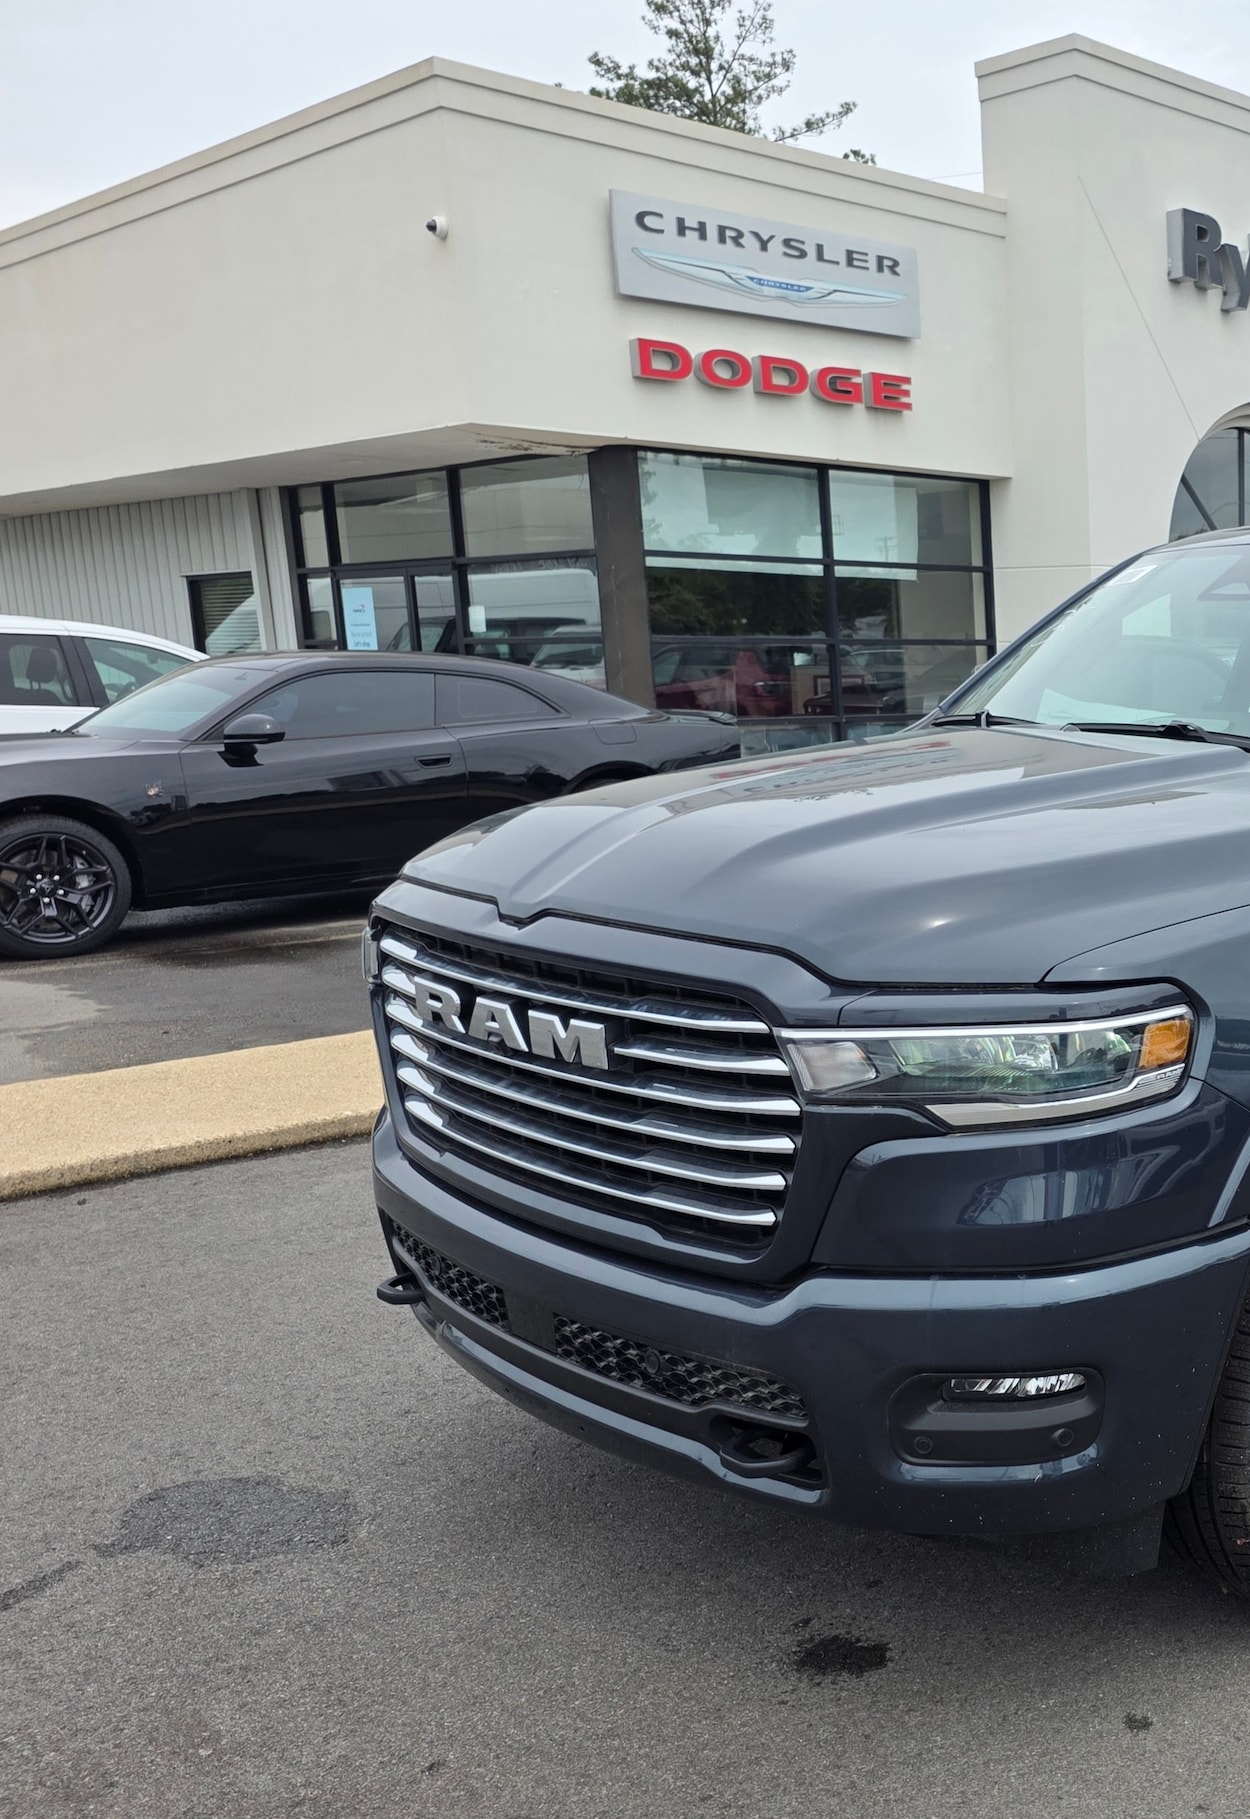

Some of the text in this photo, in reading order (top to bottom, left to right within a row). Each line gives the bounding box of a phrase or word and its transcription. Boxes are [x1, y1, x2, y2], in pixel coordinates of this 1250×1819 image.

[634, 209, 901, 277] CHRYSLER
[629, 337, 913, 411] DODGE
[414, 975, 609, 1070] RAM
